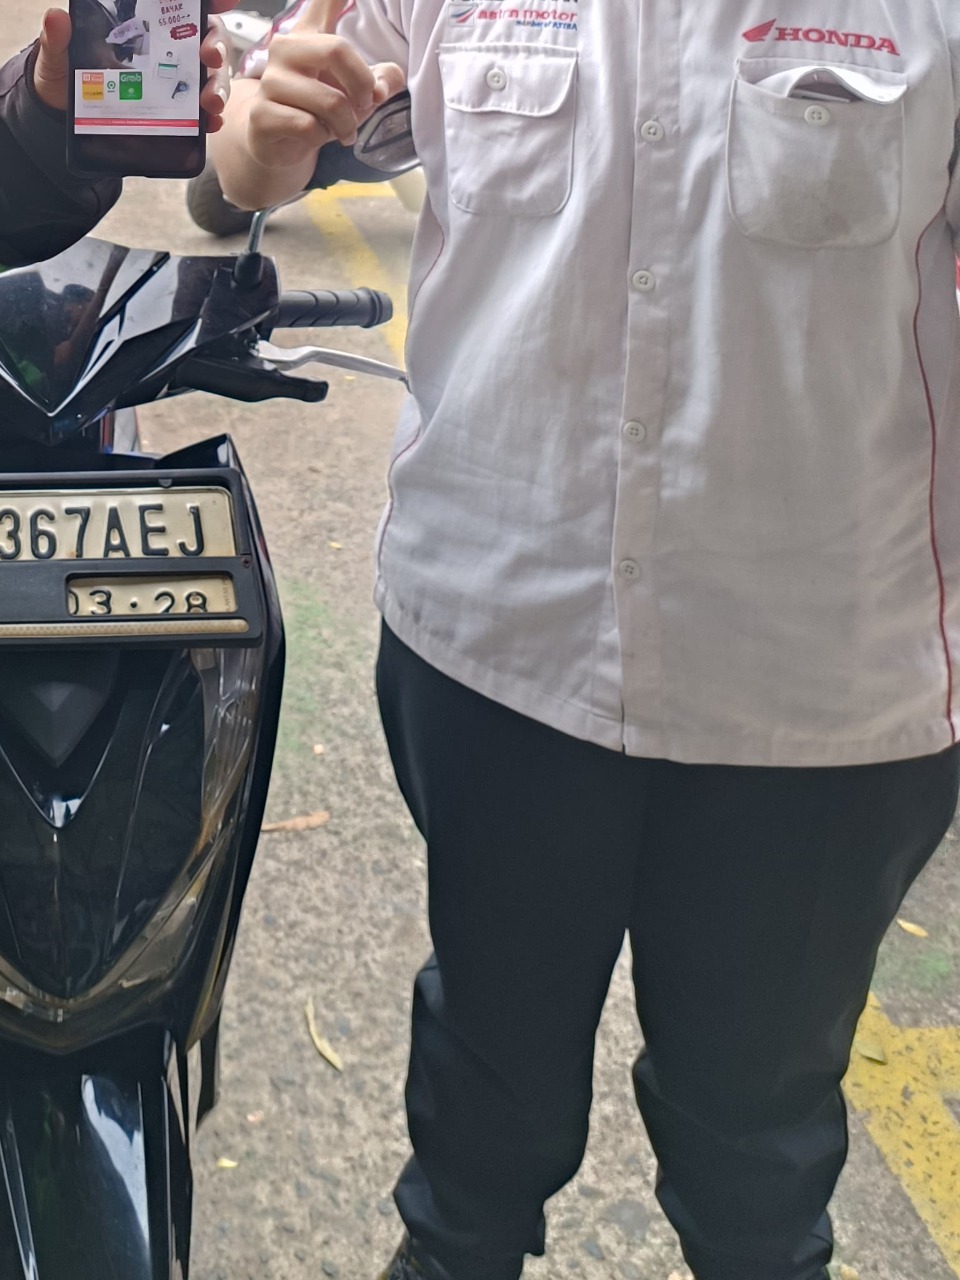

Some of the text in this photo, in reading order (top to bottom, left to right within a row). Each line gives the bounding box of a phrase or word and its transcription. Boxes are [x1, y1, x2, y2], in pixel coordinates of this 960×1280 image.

[161, 3, 183, 15] BAYAR
[477, 8, 578, 21] astra motor
[552, 21, 578, 31] ASTRA
[775, 26, 900, 56] HONDA
[120, 74, 142, 82] Grab
